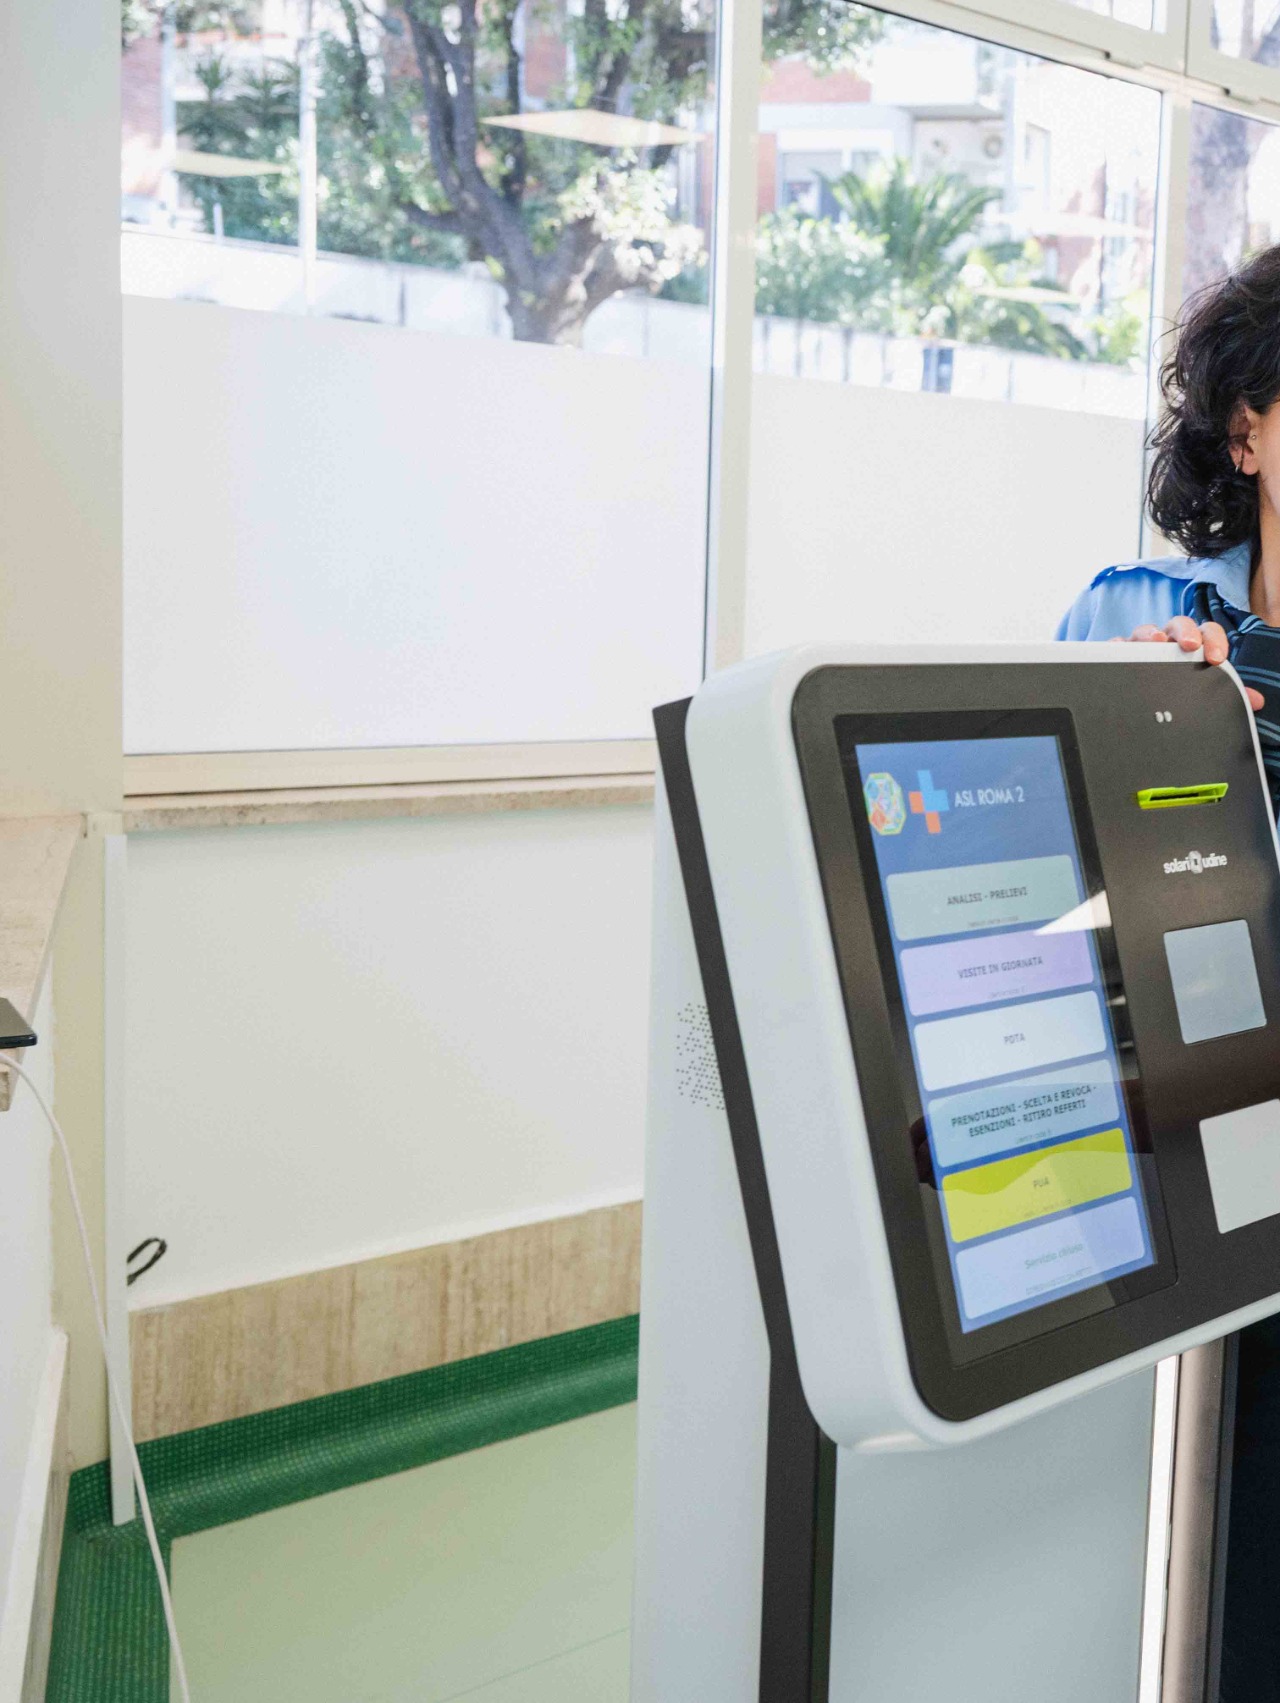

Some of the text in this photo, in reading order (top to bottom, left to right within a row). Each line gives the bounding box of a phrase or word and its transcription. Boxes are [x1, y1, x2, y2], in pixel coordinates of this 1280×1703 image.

[954, 786, 1026, 808] ASL ROMA 2
[1163, 853, 1228, 874] solari udine
[947, 891, 983, 906] ANALISI
[990, 886, 1029, 900] PRELIEVI
[957, 955, 1044, 980] VISITE IN GIORNATA
[1003, 1032, 1026, 1045] PDTA
[951, 1103, 1016, 1128] PRENOTAZIONI
[1023, 1094, 1054, 1110] SCELTA
[1055, 1092, 1060, 1102] E
[1061, 1084, 1092, 1100] REVOCA
[969, 1118, 1016, 1138] ESENZIONI
[1023, 1108, 1053, 1123] RITIRO
[1053, 1099, 1087, 1117] REFERTI
[1032, 1176, 1050, 1189] PUA
[1024, 1243, 1084, 1269] Servizio chiuso
